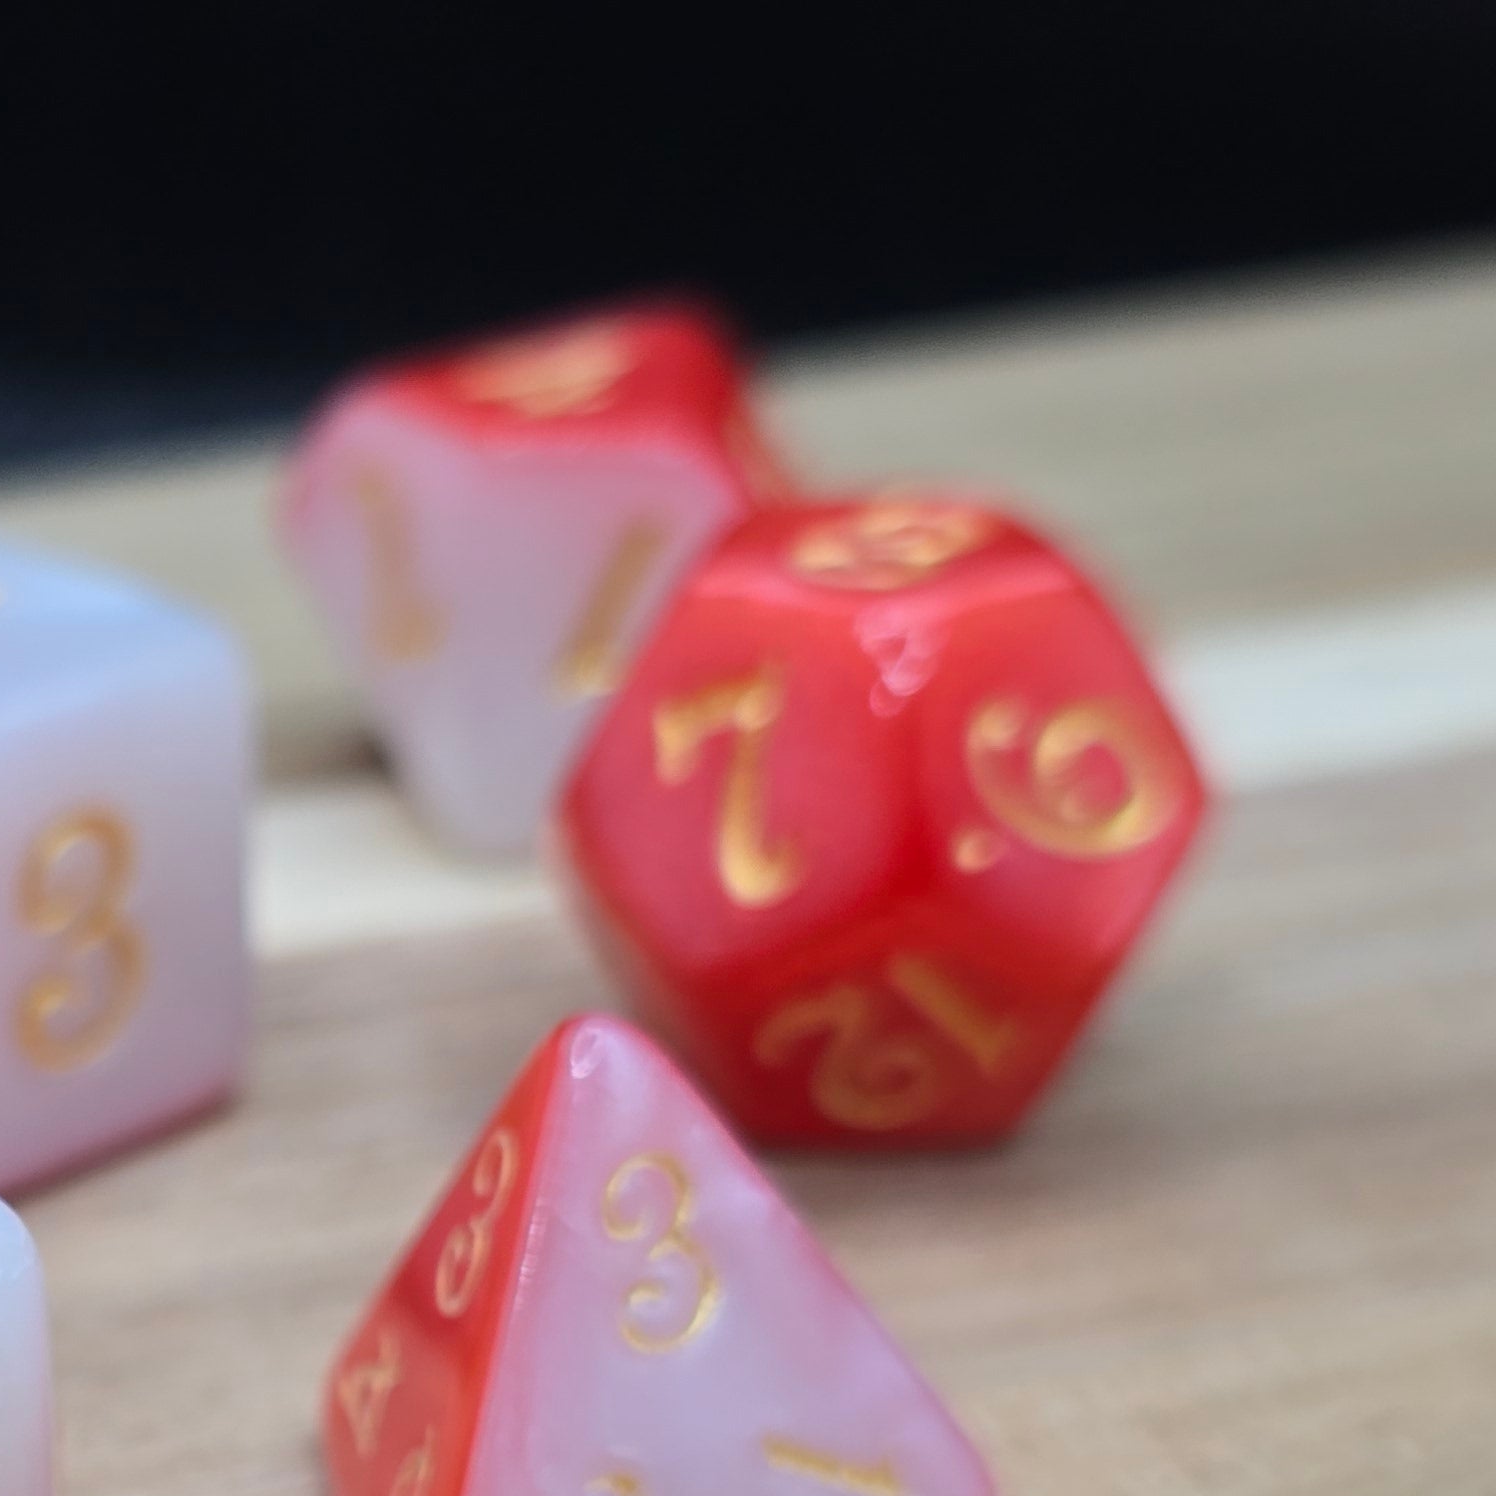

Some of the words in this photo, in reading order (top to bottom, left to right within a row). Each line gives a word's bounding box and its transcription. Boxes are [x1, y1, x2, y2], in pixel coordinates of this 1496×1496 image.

[651, 660, 801, 910] 7
[14, 800, 154, 1078] 3
[752, 950, 1019, 1132] 12
[602, 1148, 724, 1357] 3
